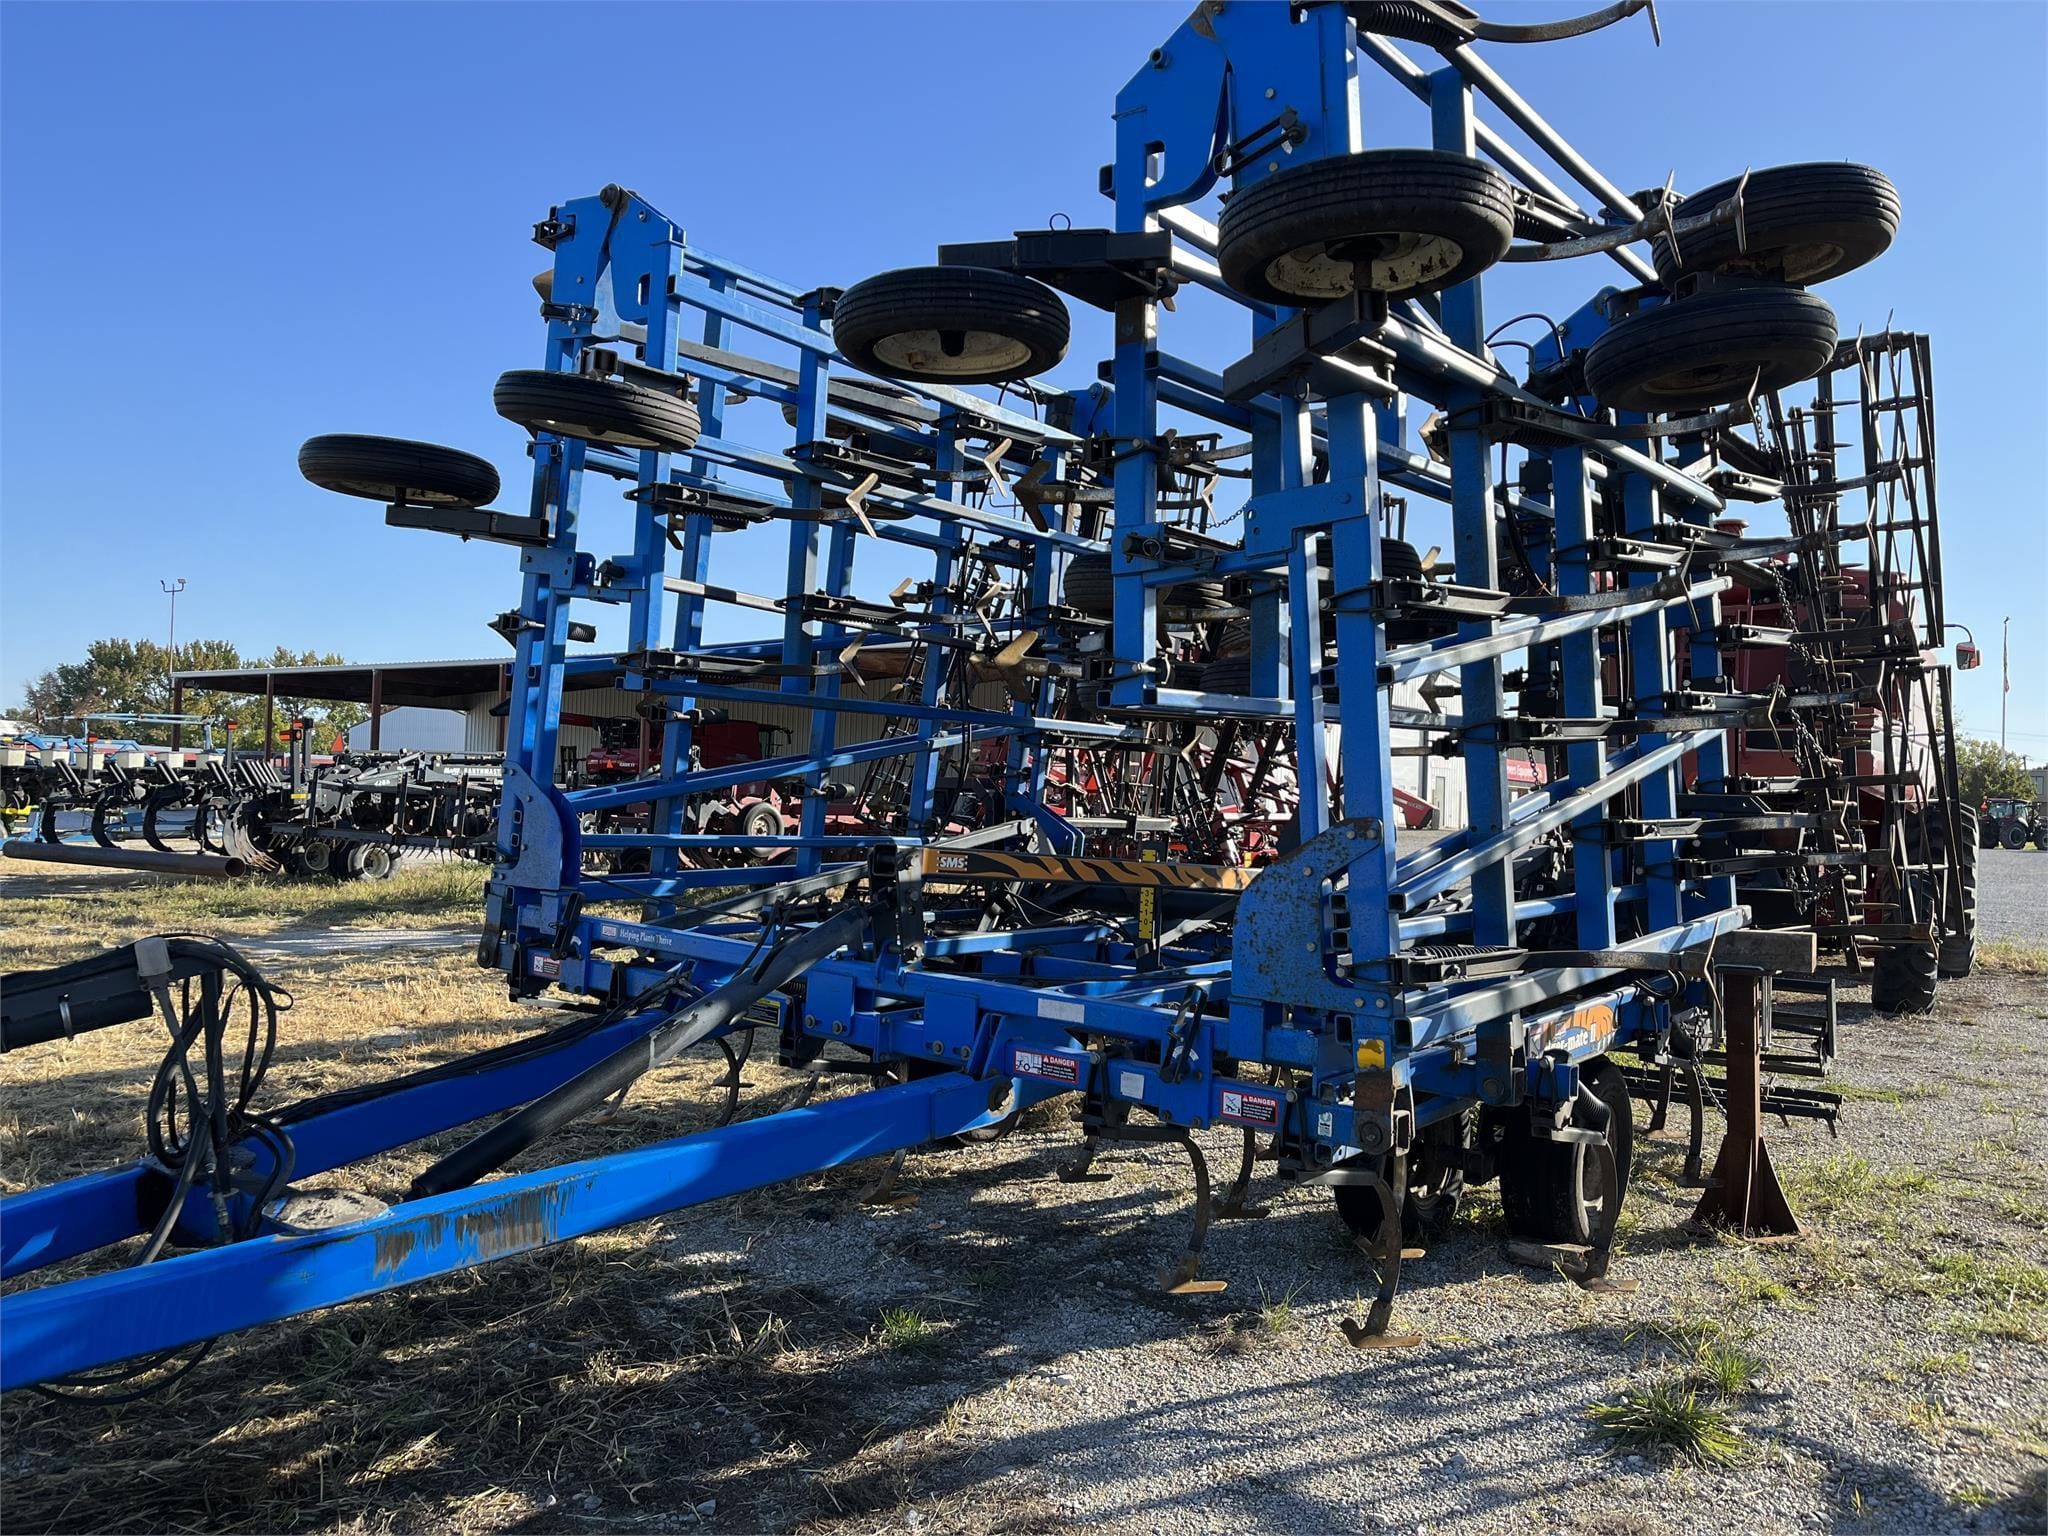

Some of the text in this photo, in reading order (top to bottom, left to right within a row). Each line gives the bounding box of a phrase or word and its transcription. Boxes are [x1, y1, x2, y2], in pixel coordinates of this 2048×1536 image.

[940, 856, 965, 868] SMS
[1144, 889, 1149, 897] 3
[1144, 899, 1149, 907] 2
[619, 928, 639, 943] Helping
[640, 931, 655, 943] Plants
[656, 934, 672, 946] Thrive
[1050, 1056, 1075, 1067] DANGER
[1248, 1096, 1276, 1107] DANGER
